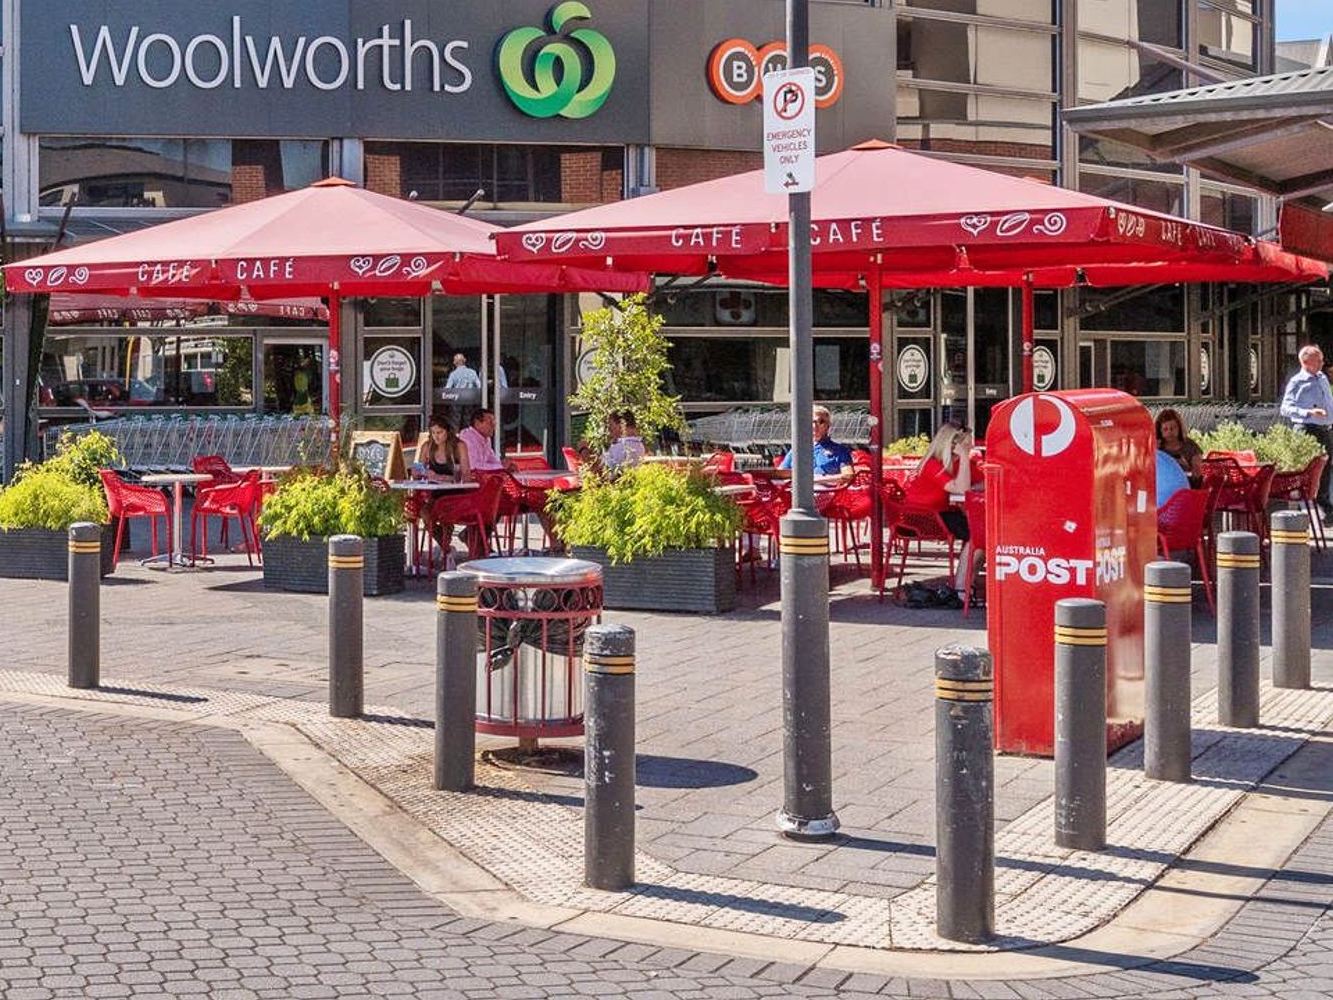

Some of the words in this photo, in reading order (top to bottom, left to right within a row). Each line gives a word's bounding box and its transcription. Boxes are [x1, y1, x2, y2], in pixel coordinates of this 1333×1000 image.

[69, 14, 474, 94] Woolworths
[732, 60, 827, 88] BS
[766, 128, 812, 142] EMERGENCY
[771, 141, 808, 153] VEHICLES
[779, 154, 800, 165] ONLY
[670, 225, 743, 248] CAFÉ
[809, 218, 885, 245] CAFÉ
[137, 262, 191, 283] CAFÉ
[236, 257, 295, 280] CAFÉ
[442, 391, 459, 401] Entry
[519, 391, 537, 400] Entry
[995, 545, 1046, 556] AUSTRALIA
[995, 555, 1094, 586] POST
